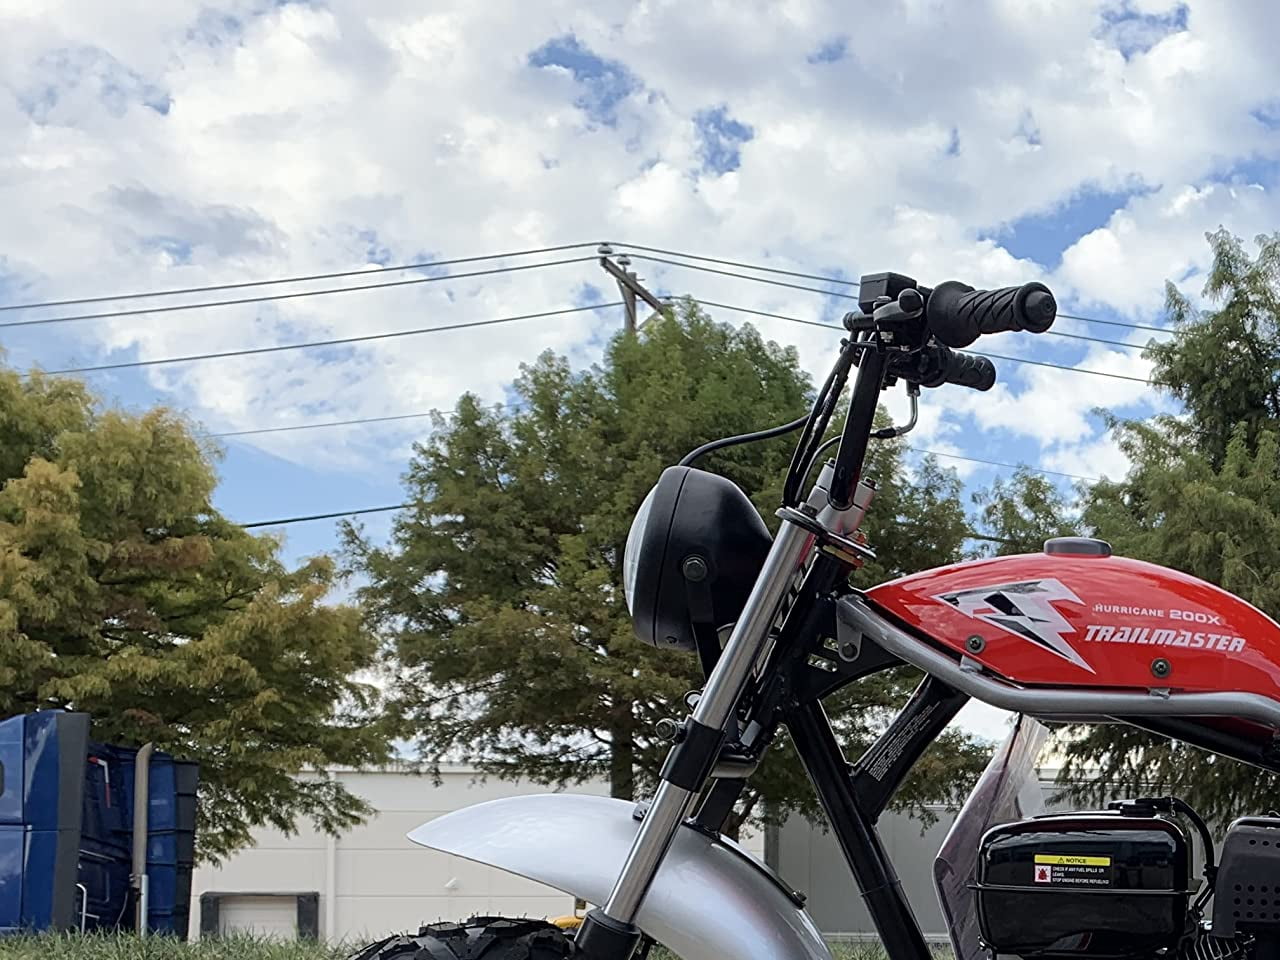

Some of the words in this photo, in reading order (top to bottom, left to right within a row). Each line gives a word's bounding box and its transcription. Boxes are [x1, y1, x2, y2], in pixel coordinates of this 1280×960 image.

[1095, 603, 1165, 618] HURRICANE
[1169, 608, 1222, 626] 200X
[1084, 623, 1247, 653] TRAILMASTER
